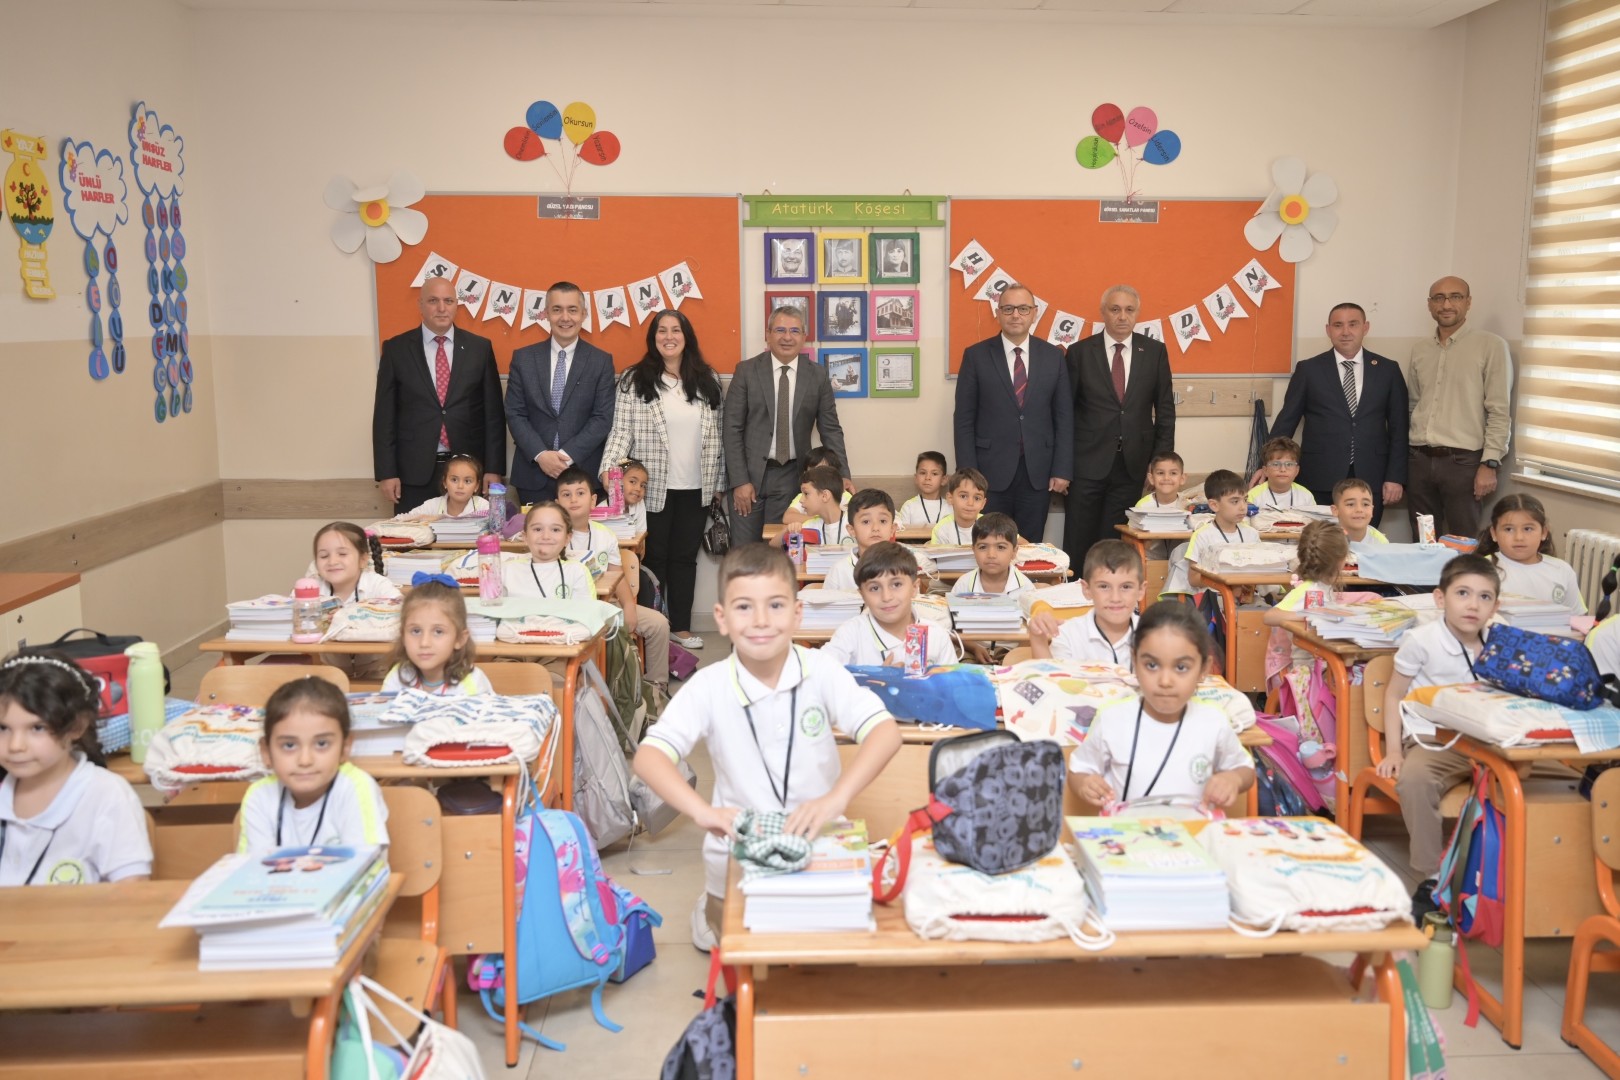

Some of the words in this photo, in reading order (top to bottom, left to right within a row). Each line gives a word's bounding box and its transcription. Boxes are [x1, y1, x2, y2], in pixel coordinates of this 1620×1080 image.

[563, 116, 593, 128] Okursun
[142, 154, 173, 173] HARFLER
[79, 172, 102, 189] ÜNLÜ
[81, 190, 115, 204] HARFLER
[771, 202, 834, 215] Atatürk
[854, 202, 906, 217] Köşesi
[163, 270, 174, 290] K
[152, 303, 163, 323] D
[166, 333, 177, 352] M
